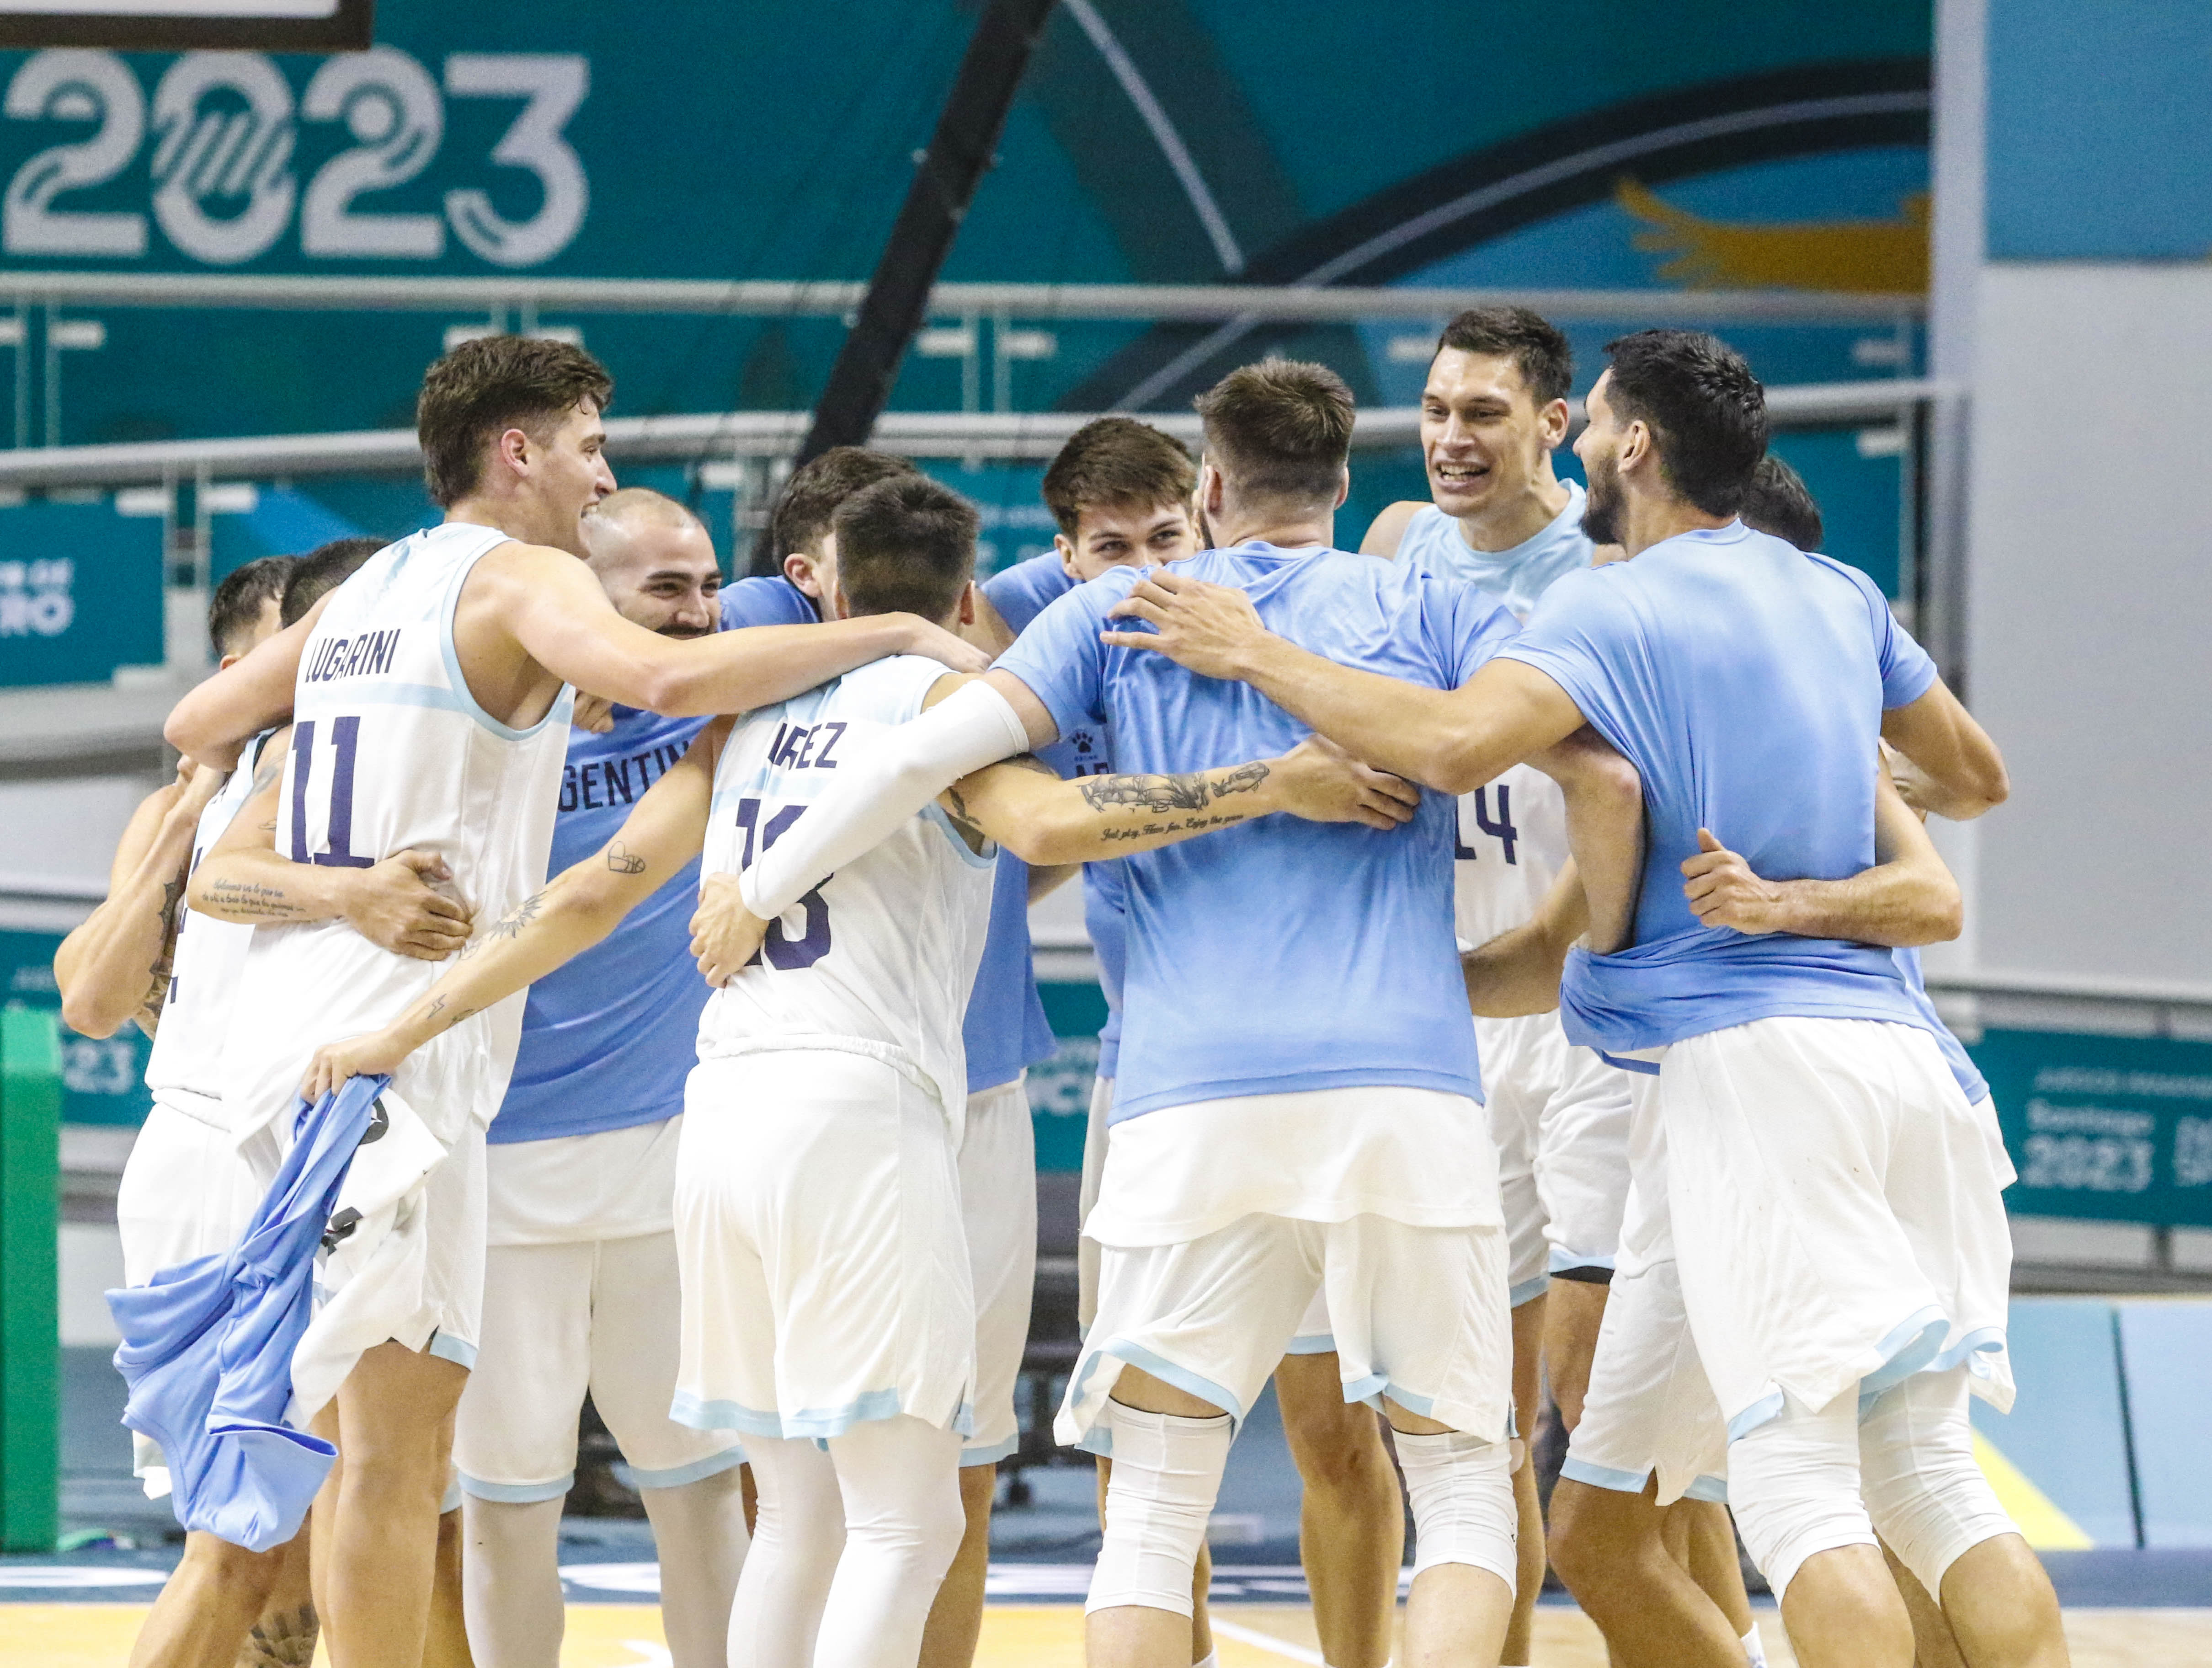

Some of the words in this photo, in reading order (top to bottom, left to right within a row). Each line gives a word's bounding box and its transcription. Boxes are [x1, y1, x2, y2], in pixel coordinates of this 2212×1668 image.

[2, 45, 591, 267] 2023
[305, 628, 401, 683] LUGARINI
[291, 716, 375, 868] 11
